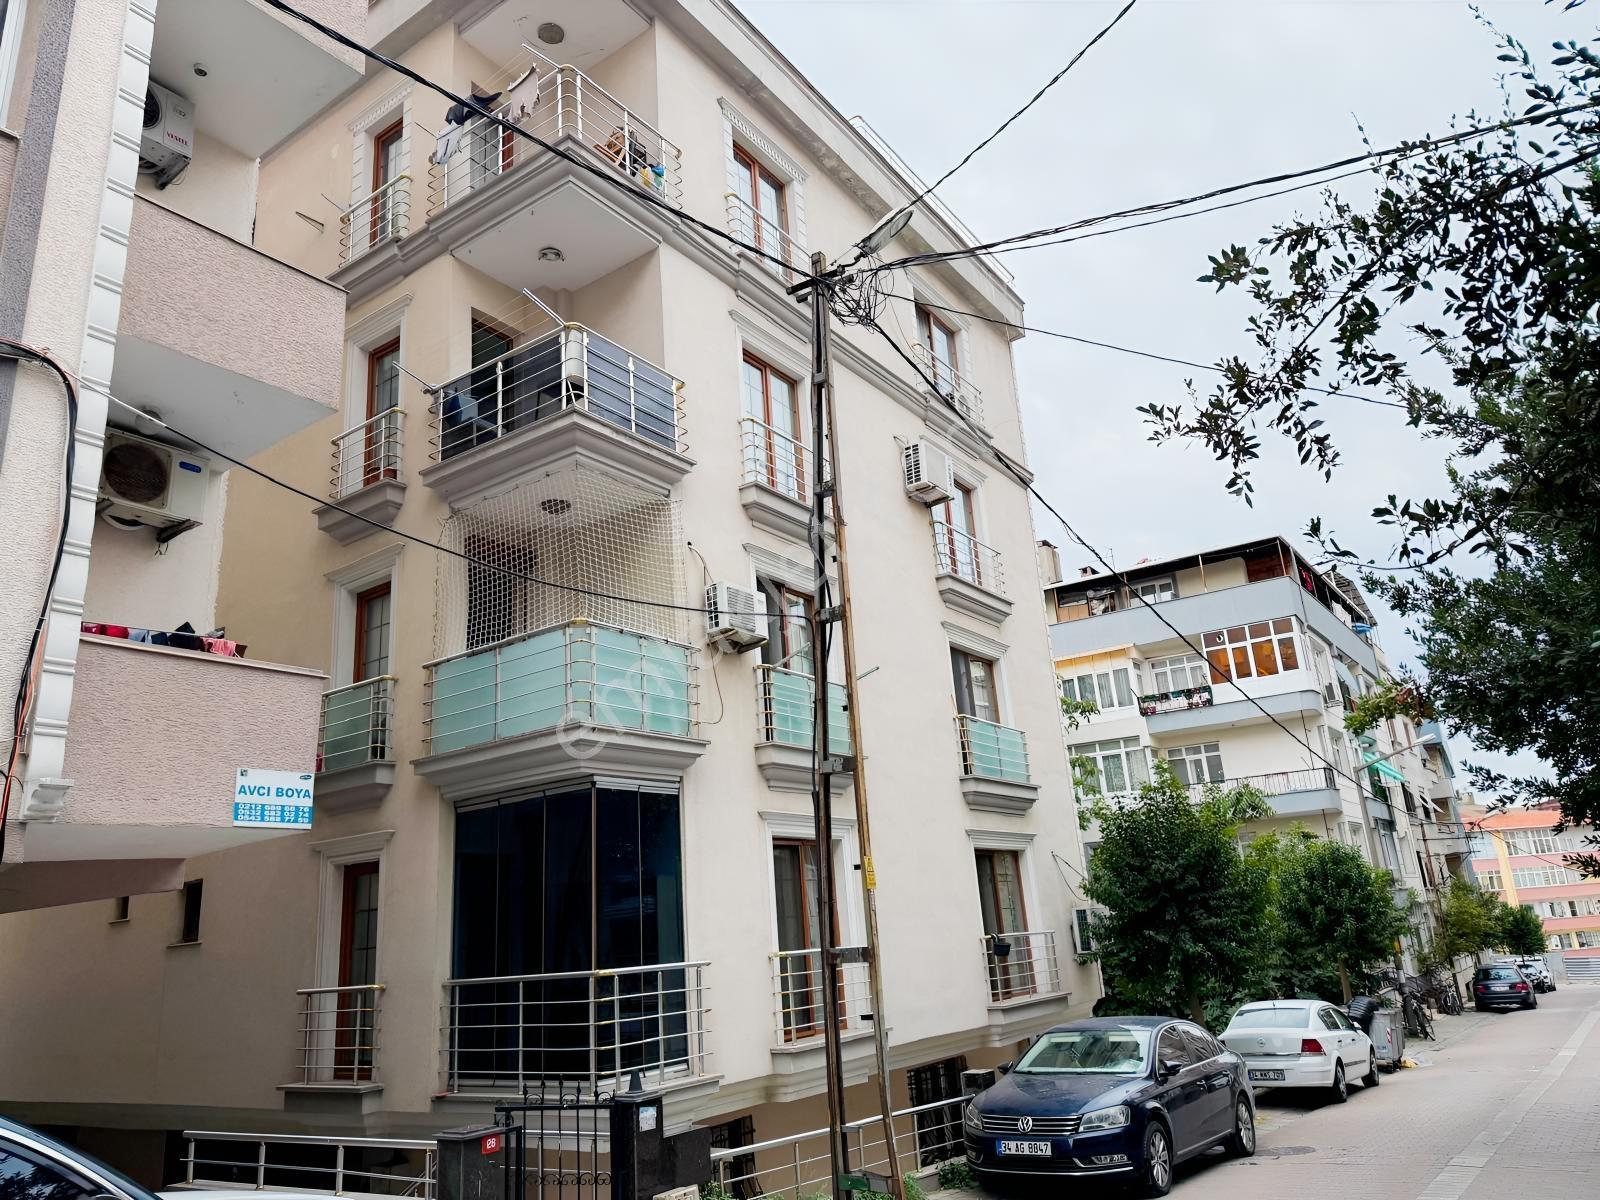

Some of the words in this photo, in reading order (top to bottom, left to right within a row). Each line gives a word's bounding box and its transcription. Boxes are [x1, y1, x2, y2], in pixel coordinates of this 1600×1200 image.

[238, 784, 271, 797] AVCI
[275, 787, 311, 799] BOYA
[1001, 1142, 1012, 1153] 34
[1015, 1142, 1025, 1153] AG
